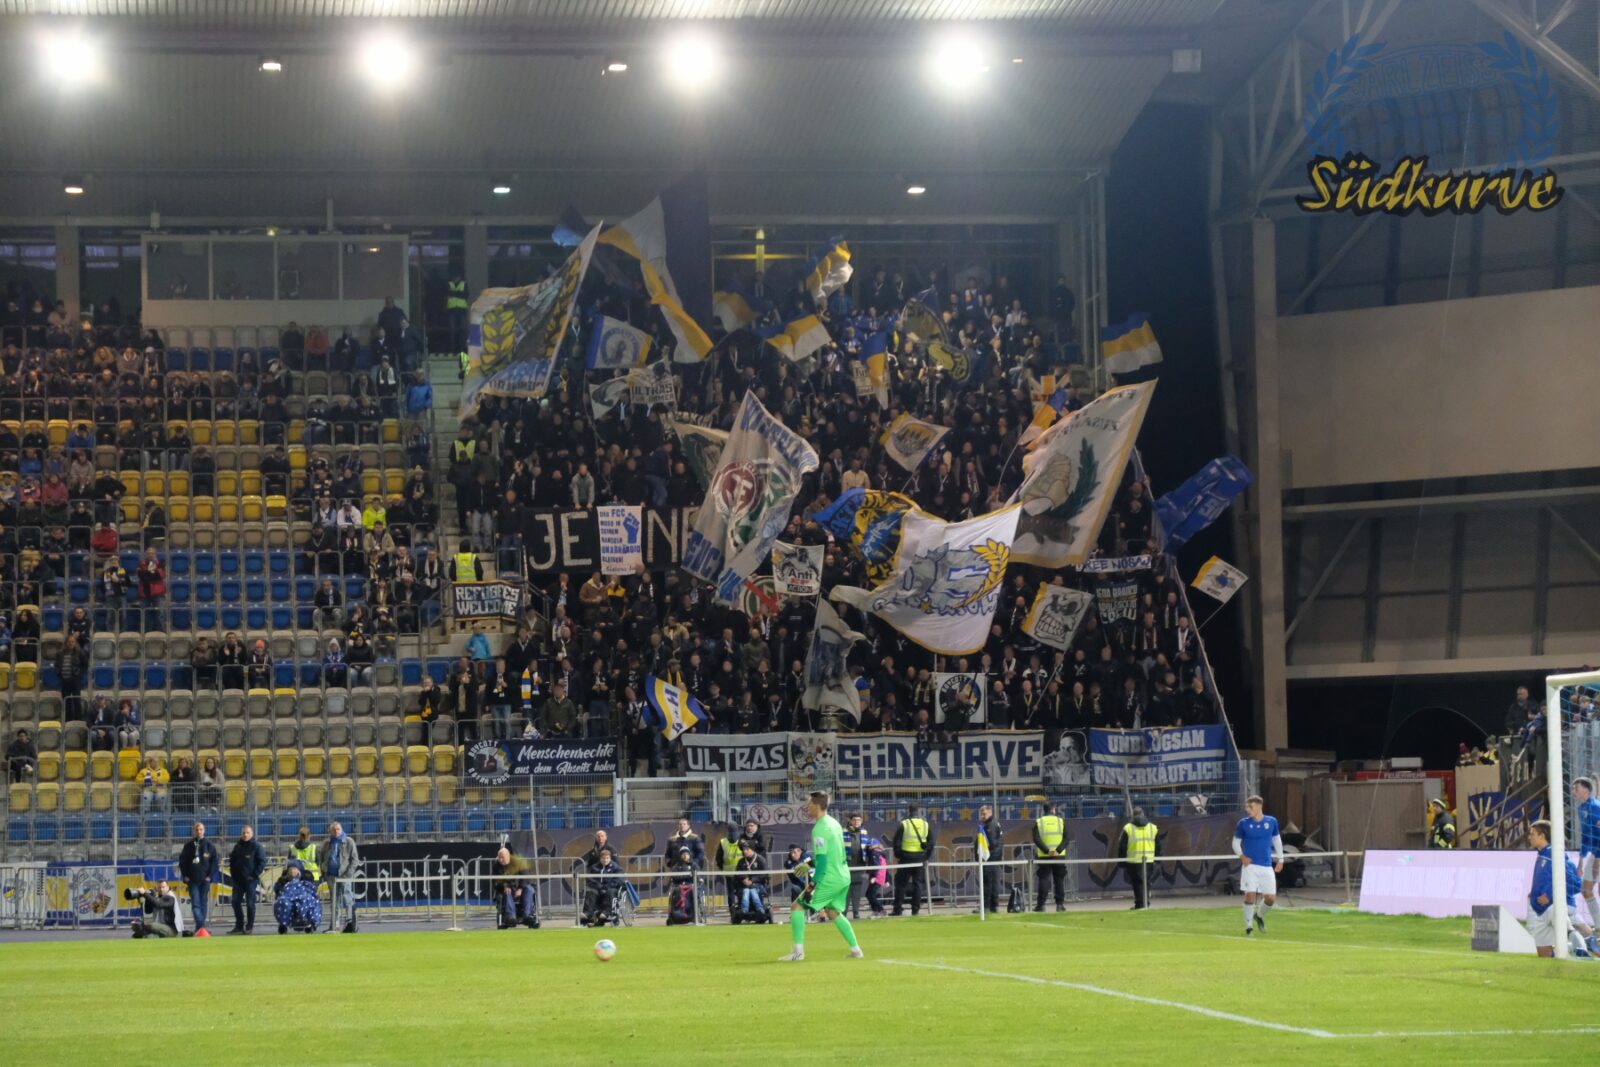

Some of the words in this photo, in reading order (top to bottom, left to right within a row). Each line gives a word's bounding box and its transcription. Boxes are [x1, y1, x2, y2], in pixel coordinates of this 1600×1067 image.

[611, 508, 626, 518] FCC
[788, 567, 813, 580] Anti
[468, 740, 499, 759] BOYCOTT
[517, 743, 616, 762] Menschenrechte
[686, 745, 786, 772] ULTRAS
[514, 765, 530, 775] aus
[533, 762, 552, 774] dem
[556, 761, 592, 776] Abseits
[593, 760, 616, 772] holen
[837, 740, 1041, 780] SÜDKURVE
[1094, 760, 1224, 786] UNVERKÄUFLICH
[352, 854, 483, 900] Saalfel
